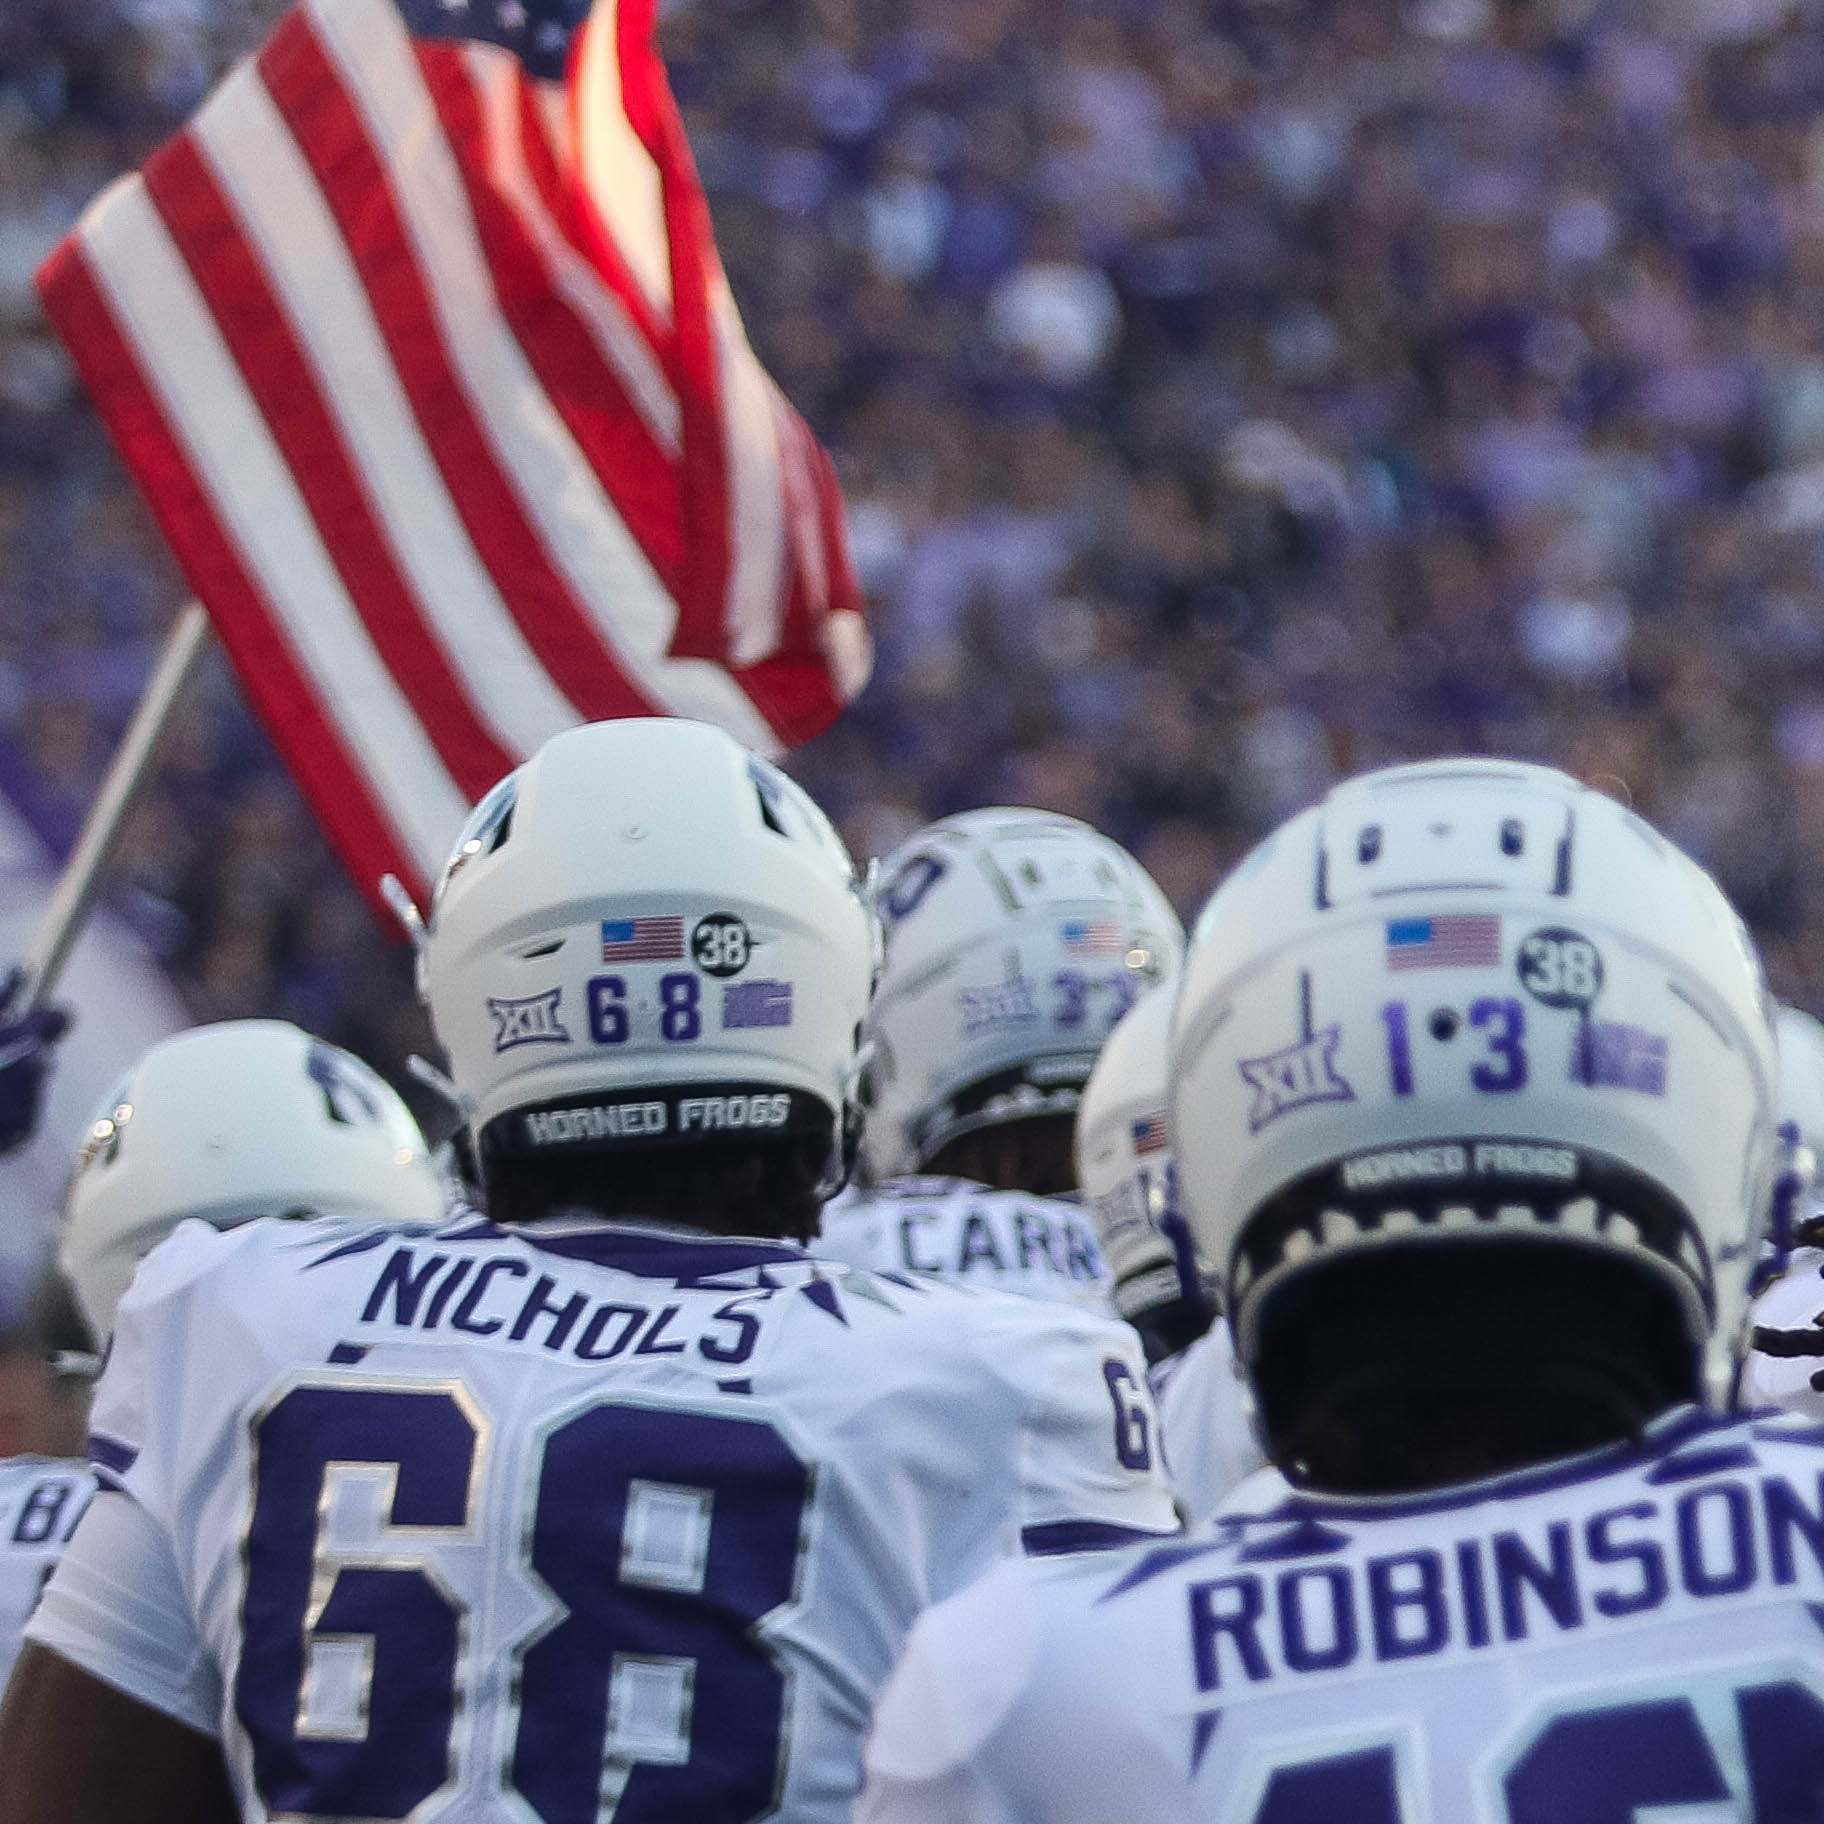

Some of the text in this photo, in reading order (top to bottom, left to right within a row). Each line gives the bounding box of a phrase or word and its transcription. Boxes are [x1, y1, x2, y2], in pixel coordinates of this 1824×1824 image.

[696, 922, 750, 968] 38
[1521, 937, 1600, 1002] 38
[587, 973, 700, 1043] 68
[527, 1094, 792, 1145] HORNED FROGS
[361, 1250, 761, 1364] NICHOLS
